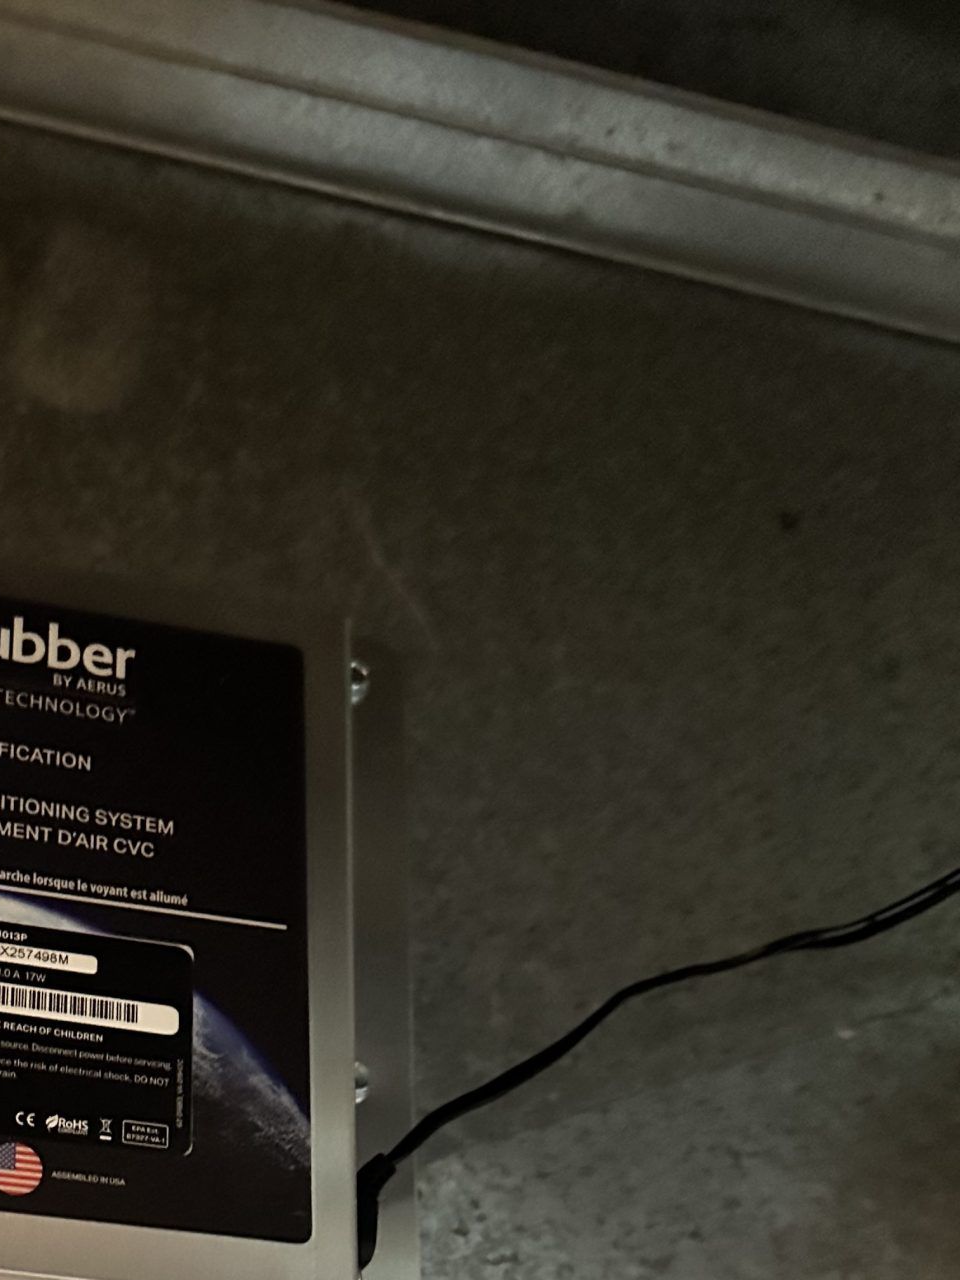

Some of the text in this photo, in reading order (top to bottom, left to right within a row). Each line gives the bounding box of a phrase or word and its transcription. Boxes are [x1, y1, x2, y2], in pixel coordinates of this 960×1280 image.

[52, 672, 126, 697] BY AERUS
[94, 808, 173, 836] SYSTEM
[57, 828, 108, 851] D'AIR
[112, 836, 154, 858] CVC
[32, 872, 75, 892] lorsque
[76, 878, 88, 892] le
[89, 881, 128, 900] voyant
[129, 887, 147, 901] est
[149, 888, 188, 906] allumé
[0, 945, 69, 965] X257498M
[2, 1020, 37, 1034] REACH
[38, 1025, 51, 1035] OF
[53, 1028, 103, 1042] CHILDREN
[13, 1058, 28, 1067] the
[30, 1061, 46, 1070] risk
[48, 1063, 58, 1071] of
[134, 1074, 147, 1083] DO
[149, 1076, 168, 1087] NOT
[58, 1116, 88, 1131] RoHS
[109, 1177, 125, 1186] USA
